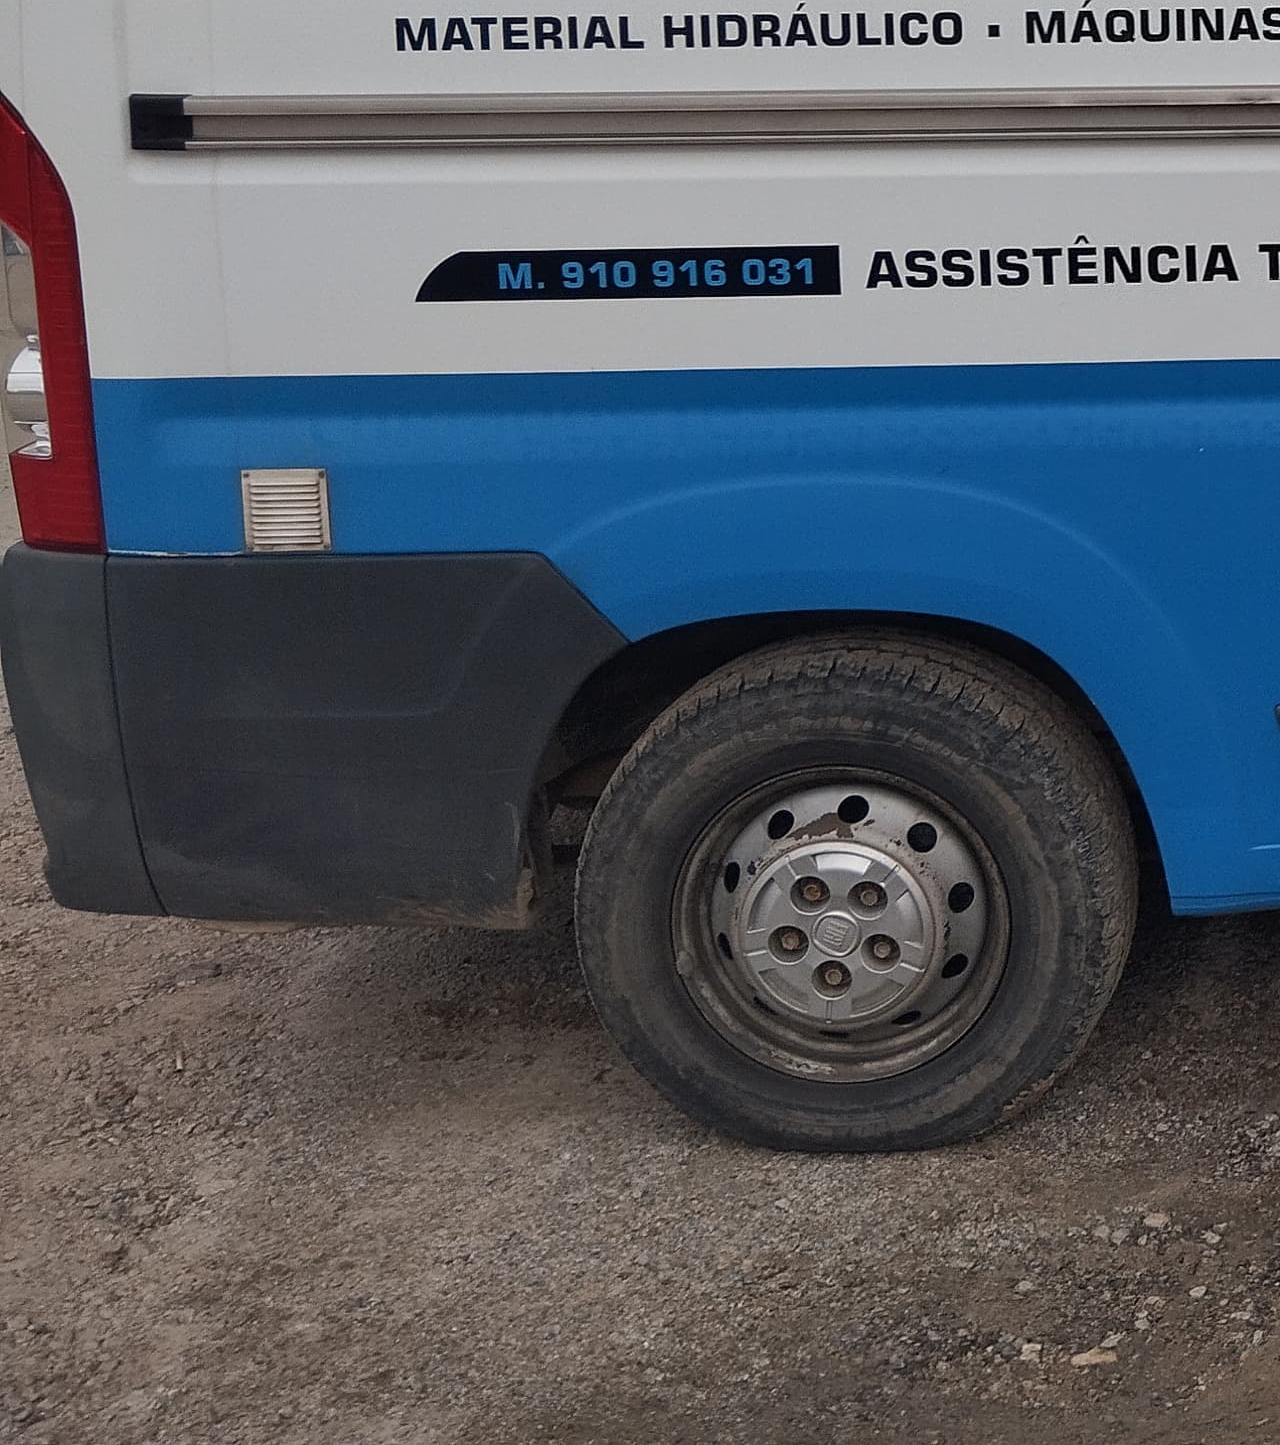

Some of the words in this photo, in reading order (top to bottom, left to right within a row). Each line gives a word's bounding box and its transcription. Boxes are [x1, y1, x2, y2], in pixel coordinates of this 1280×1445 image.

[395, 15, 645, 52] MATERIAL
[663, 2, 963, 49] HIDRÁULICO
[497, 262, 545, 290] M.
[561, 260, 637, 289] 910
[651, 259, 727, 288] 916
[742, 257, 813, 286] 031
[865, 235, 1239, 289] ASSISTÊNCIA
